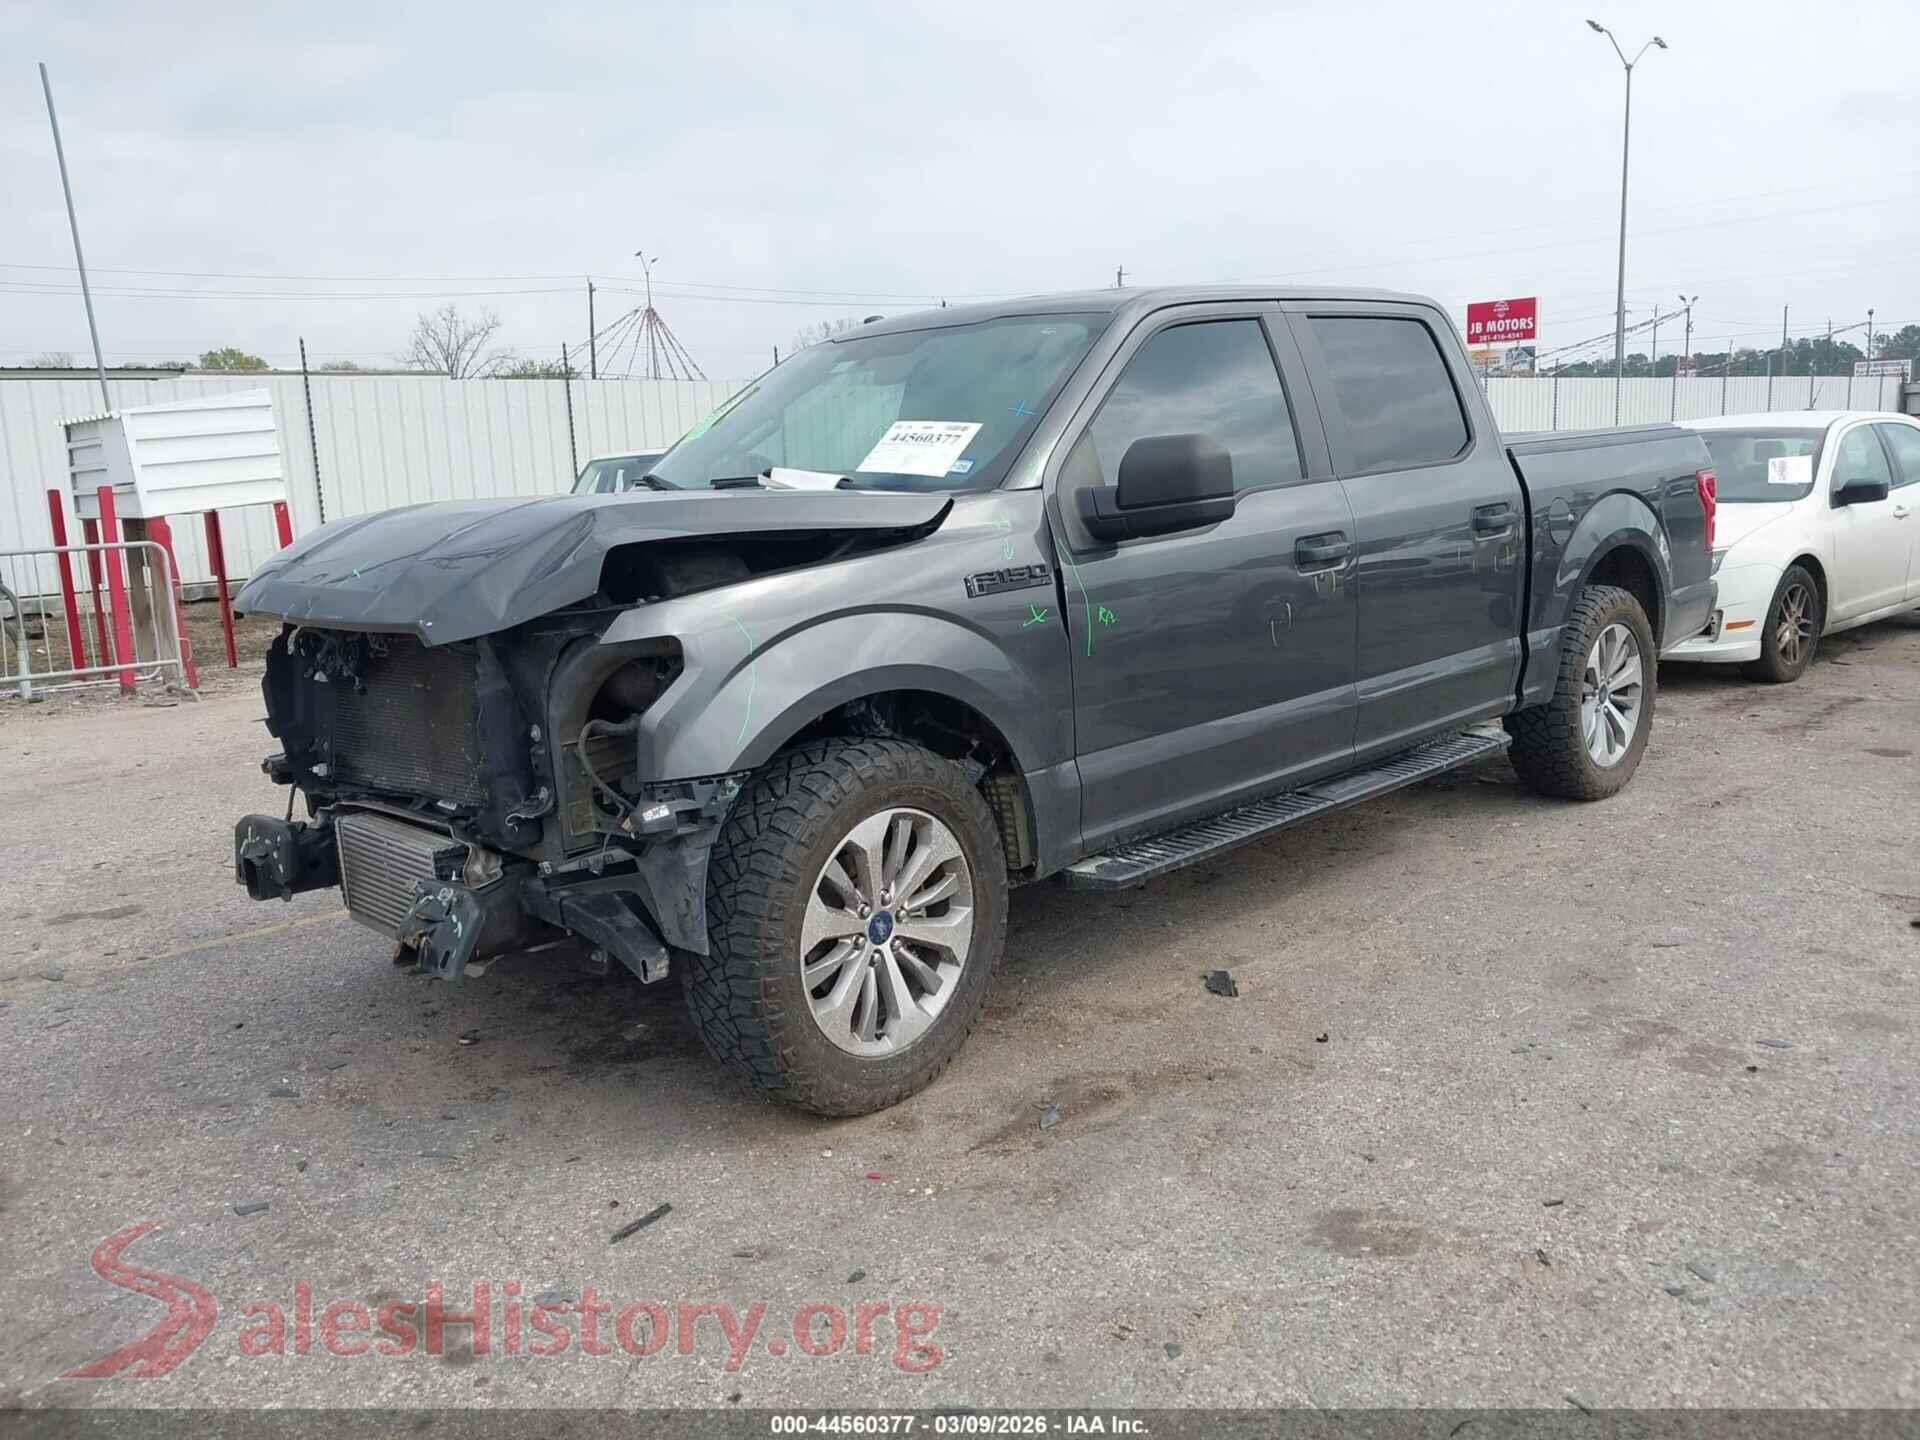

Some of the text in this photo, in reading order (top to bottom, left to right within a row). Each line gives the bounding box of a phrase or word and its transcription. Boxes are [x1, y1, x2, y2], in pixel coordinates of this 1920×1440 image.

[1470, 317, 1534, 335] JB MOTORS
[889, 432, 962, 445] 44560377
